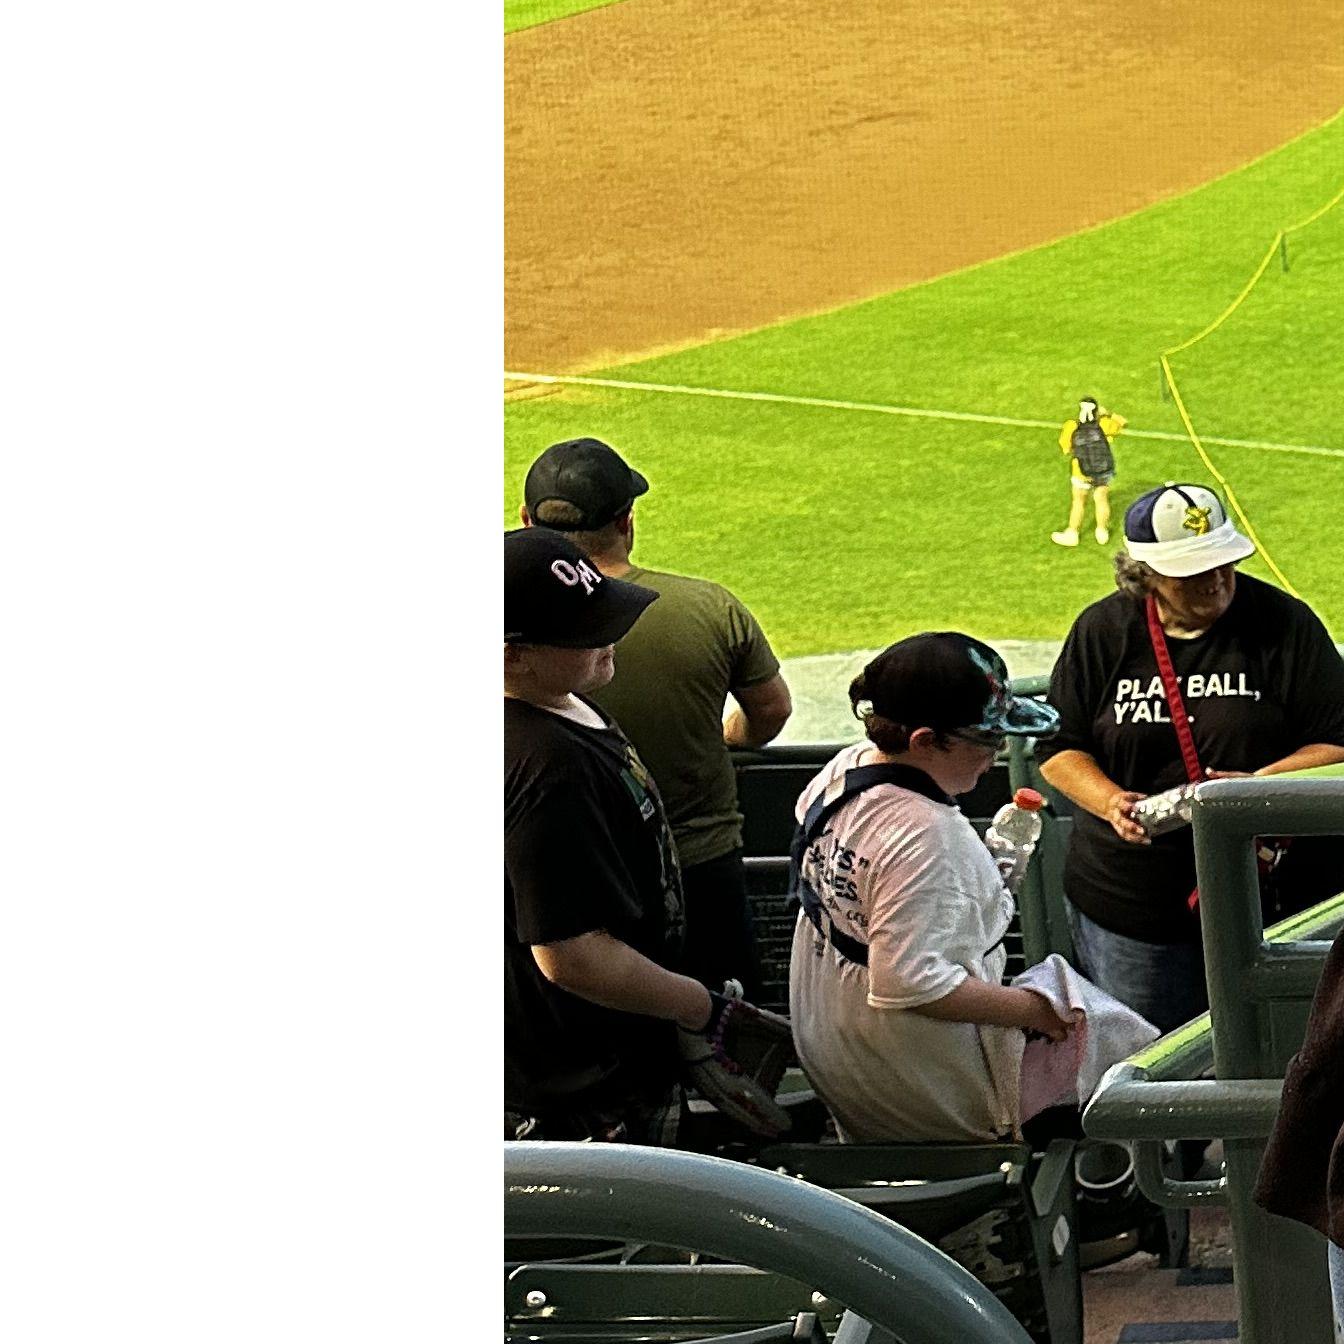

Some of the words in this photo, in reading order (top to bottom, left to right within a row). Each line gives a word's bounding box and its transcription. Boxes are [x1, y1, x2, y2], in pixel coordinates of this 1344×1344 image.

[551, 559, 602, 596] OM
[1116, 675, 1183, 702] PLA
[1187, 672, 1262, 702] BALL,
[1113, 700, 1195, 725] Y'AL.
